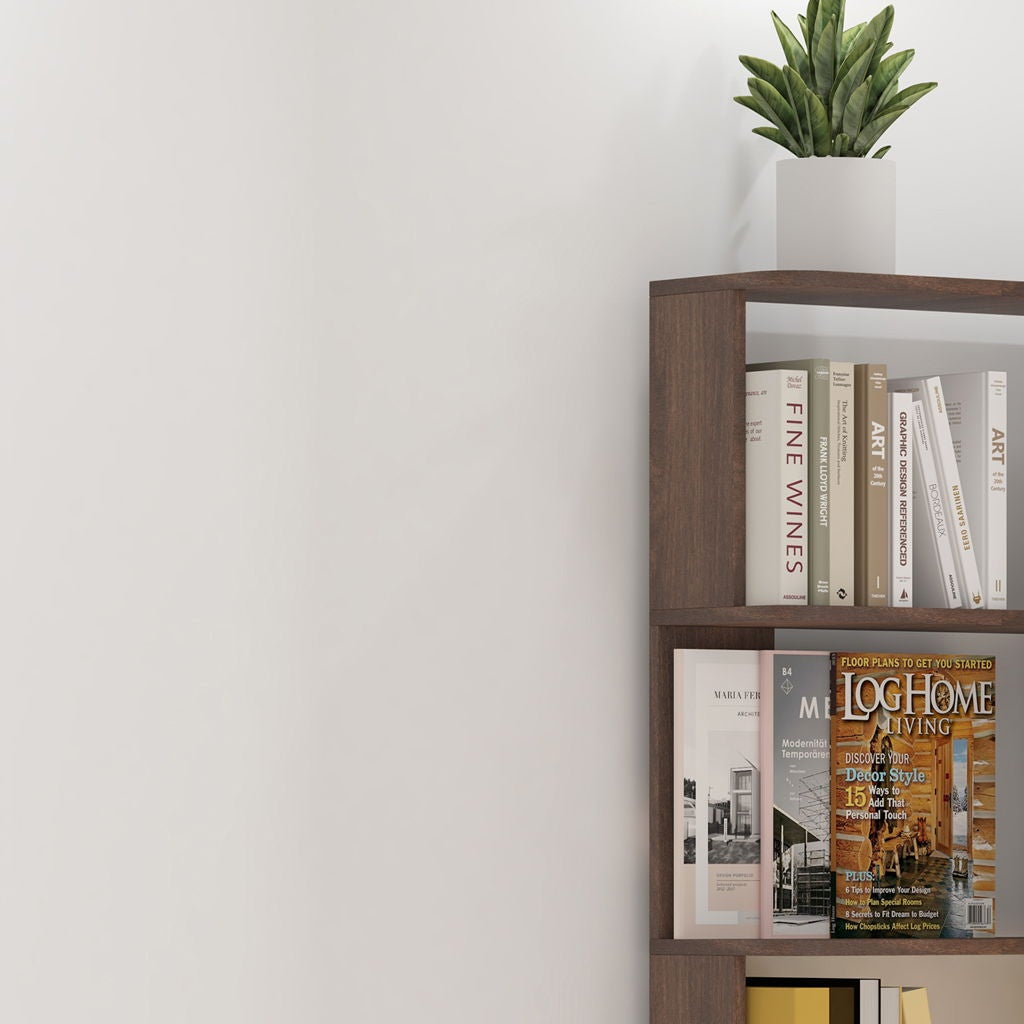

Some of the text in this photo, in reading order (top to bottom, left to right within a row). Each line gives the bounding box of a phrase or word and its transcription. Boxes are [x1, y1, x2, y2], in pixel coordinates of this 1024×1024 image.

[872, 421, 885, 459] ART
[992, 428, 1005, 464] ART
[787, 403, 802, 572] FINE WINES
[929, 484, 946, 537] BORDEAUX
[952, 485, 970, 550] EERO SAARINEN
[841, 657, 869, 667] FLOOR
[872, 658, 899, 667] PLANS
[903, 658, 913, 668] TO
[916, 659, 932, 668] GET
[936, 659, 951, 668] YOU
[955, 659, 992, 669] STARTED
[714, 690, 742, 700] MARIA
[887, 718, 950, 735] LIVING
[782, 739, 827, 748] Modernität
[846, 753, 909, 764] DISCOVER YOUR
[845, 767, 926, 786] Decor Style
[845, 786, 900, 807] 15 Ways to
[868, 798, 904, 807] Add That
[846, 810, 907, 820] Personal Touch
[845, 872, 875, 881] PLUS:
[919, 911, 939, 919] Budget
[860, 923, 890, 931] Chopsticks
